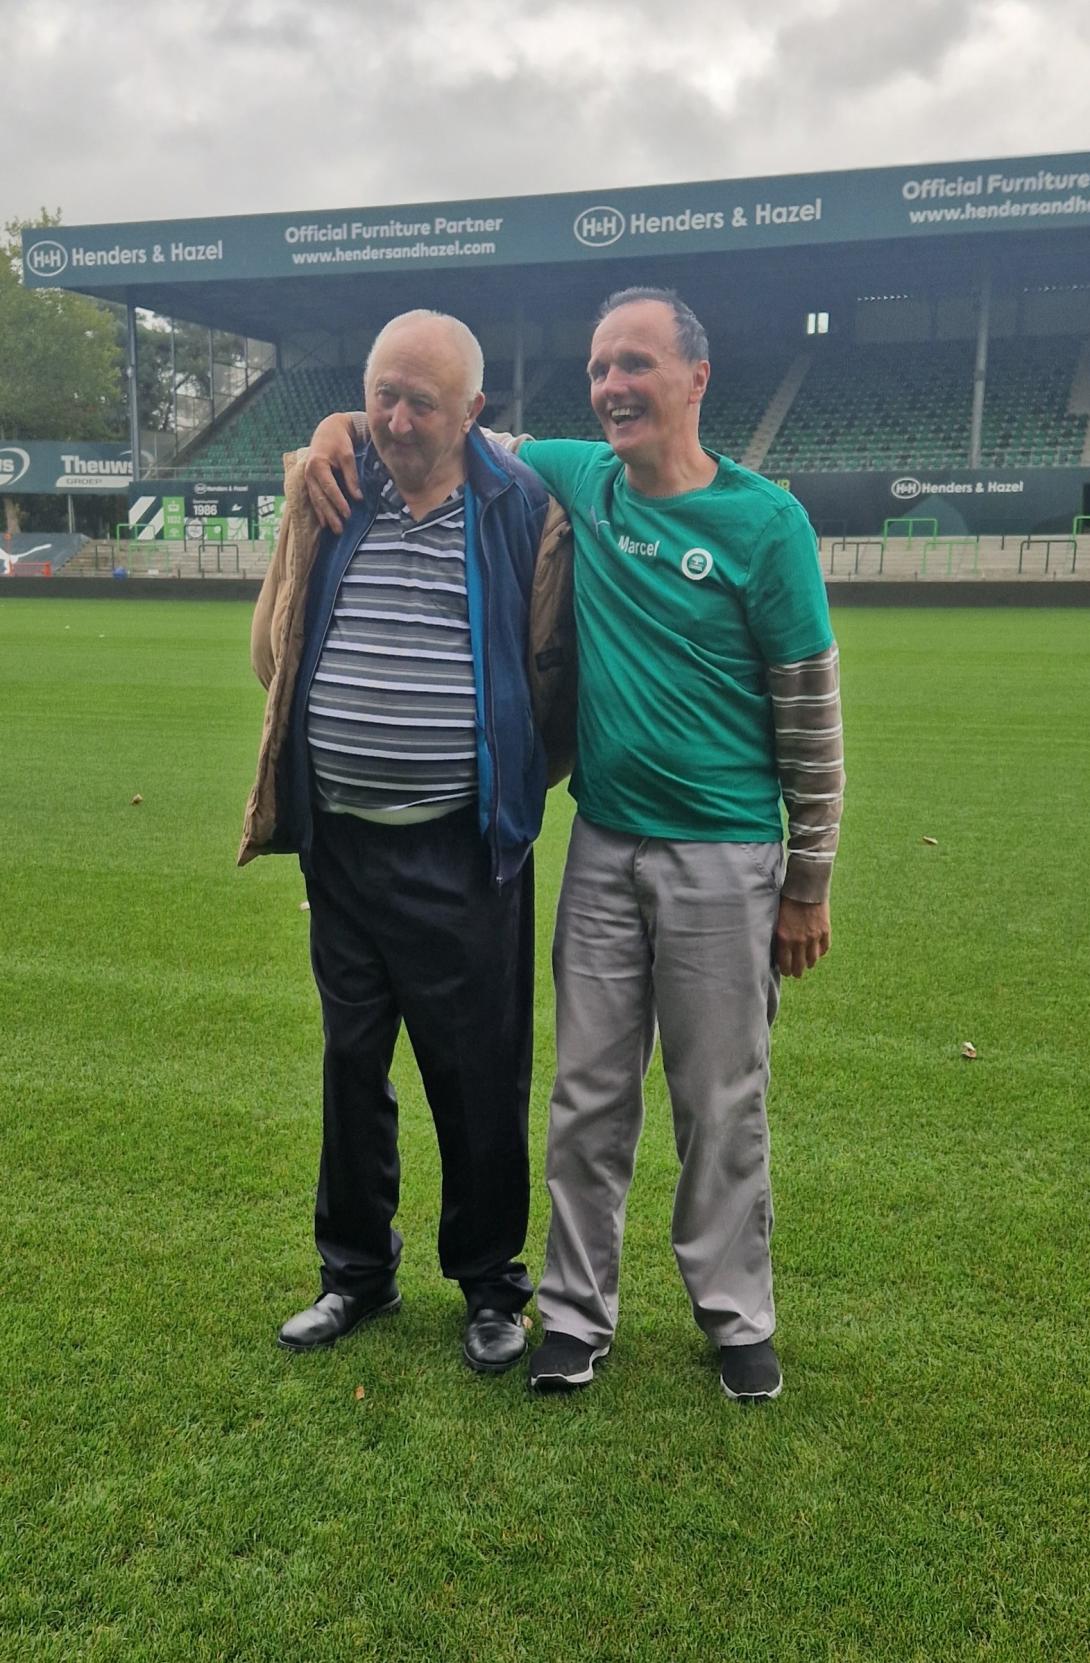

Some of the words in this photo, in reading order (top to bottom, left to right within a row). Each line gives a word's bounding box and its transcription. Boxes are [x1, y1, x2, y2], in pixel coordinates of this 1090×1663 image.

[902, 175, 982, 200] Official
[987, 170, 1090, 194] Furniture
[630, 209, 724, 234] Henders
[731, 207, 747, 227] &
[755, 198, 822, 225] Hazel
[909, 196, 1090, 223] www.hendersandh
[285, 224, 347, 243] Official
[351, 220, 431, 239] Furniture
[435, 216, 503, 235] Partner
[72, 245, 147, 266] Henders
[152, 244, 165, 262] &
[170, 240, 223, 261] Hazel
[292, 240, 496, 264] www.hendersandhazel.com
[921, 482, 973, 493] Henders
[975, 482, 985, 493] &
[988, 481, 1024, 492] Hazel
[618, 535, 660, 556] Marcel
